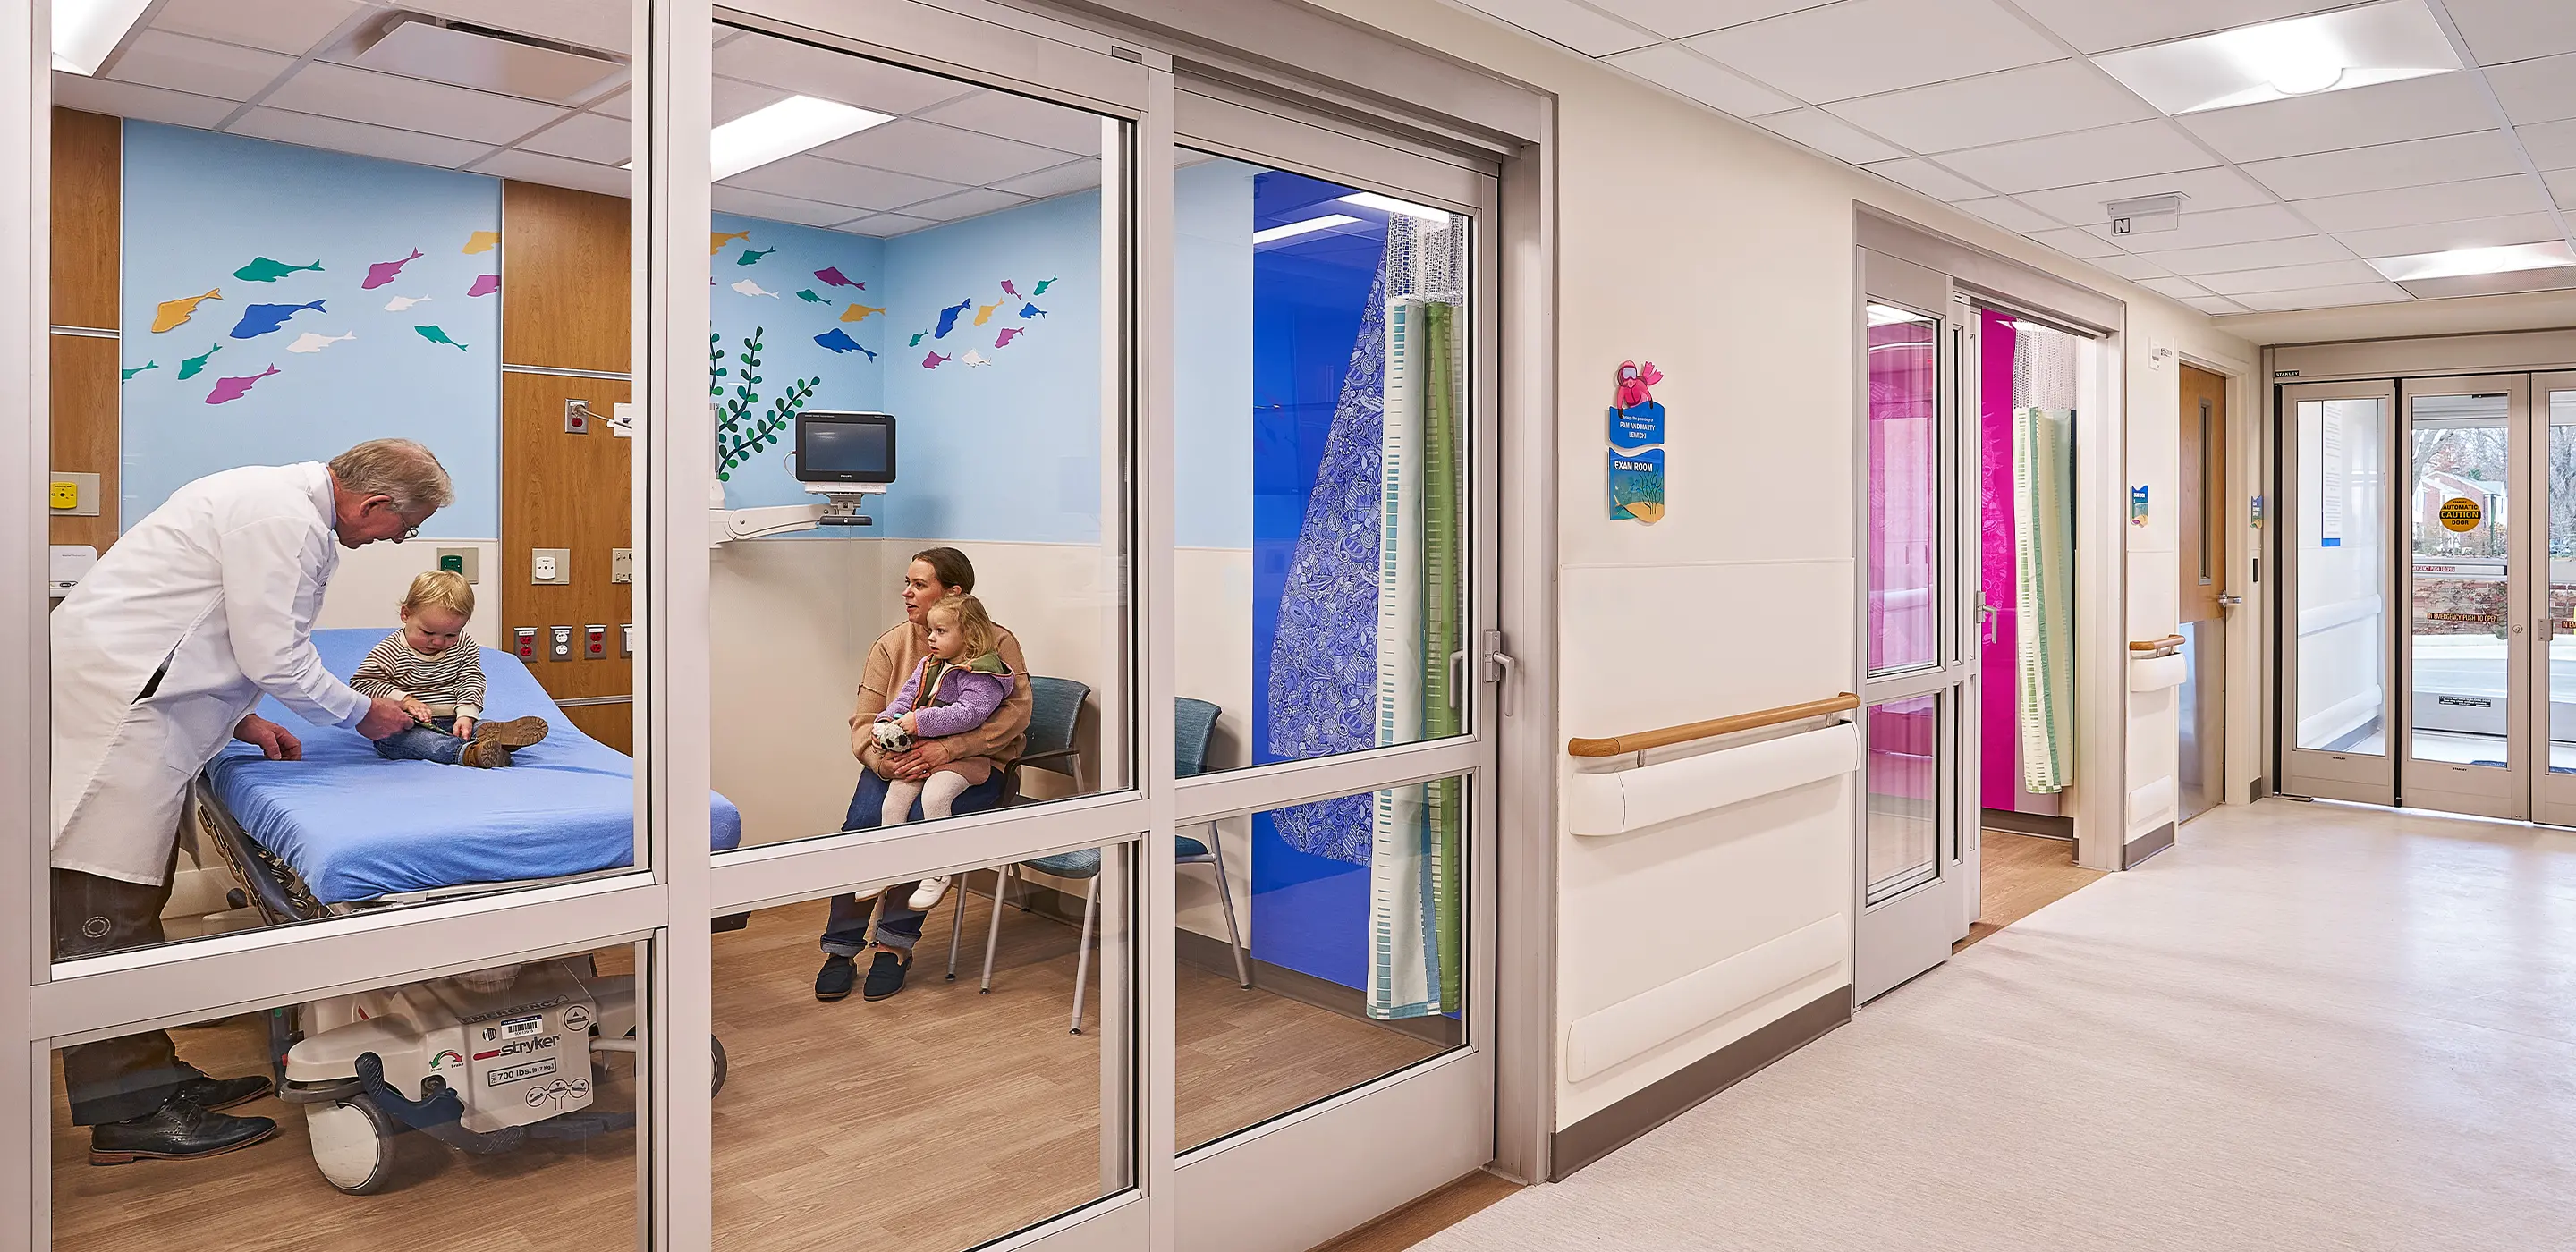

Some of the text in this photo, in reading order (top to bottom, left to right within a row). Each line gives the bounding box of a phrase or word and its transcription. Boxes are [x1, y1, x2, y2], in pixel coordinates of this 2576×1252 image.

[1640, 423, 1656, 431] MARTY
[1614, 461, 1653, 472] EXAM ROOM
[2433, 613, 2462, 621] EMERGENCY
[500, 1036, 561, 1057] stryker
[497, 1070, 514, 1080] 700
[516, 1069, 532, 1077] lbs.
